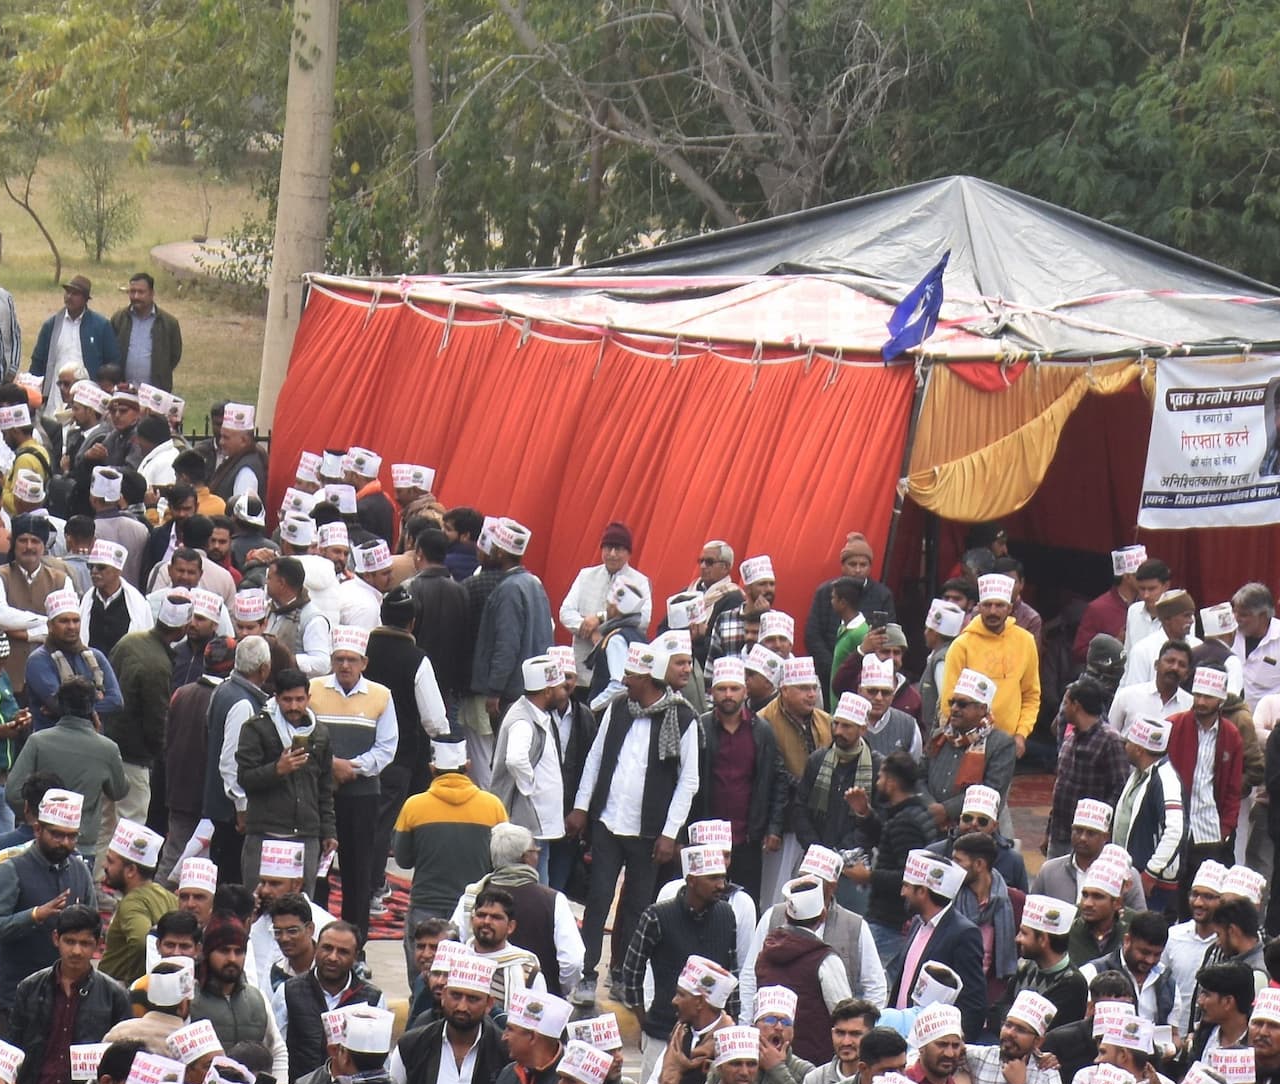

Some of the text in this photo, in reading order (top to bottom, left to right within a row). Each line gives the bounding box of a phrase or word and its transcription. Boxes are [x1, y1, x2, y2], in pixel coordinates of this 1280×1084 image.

[1196, 388, 1232, 406] सन्तोष
[1233, 388, 1266, 403] नायक
[1181, 425, 1249, 450] गिरफ्तार करने
[1222, 453, 1236, 464] लेकर
[1160, 473, 1229, 488] अनिश्चितकालीन
[1174, 493, 1195, 504] जिला
